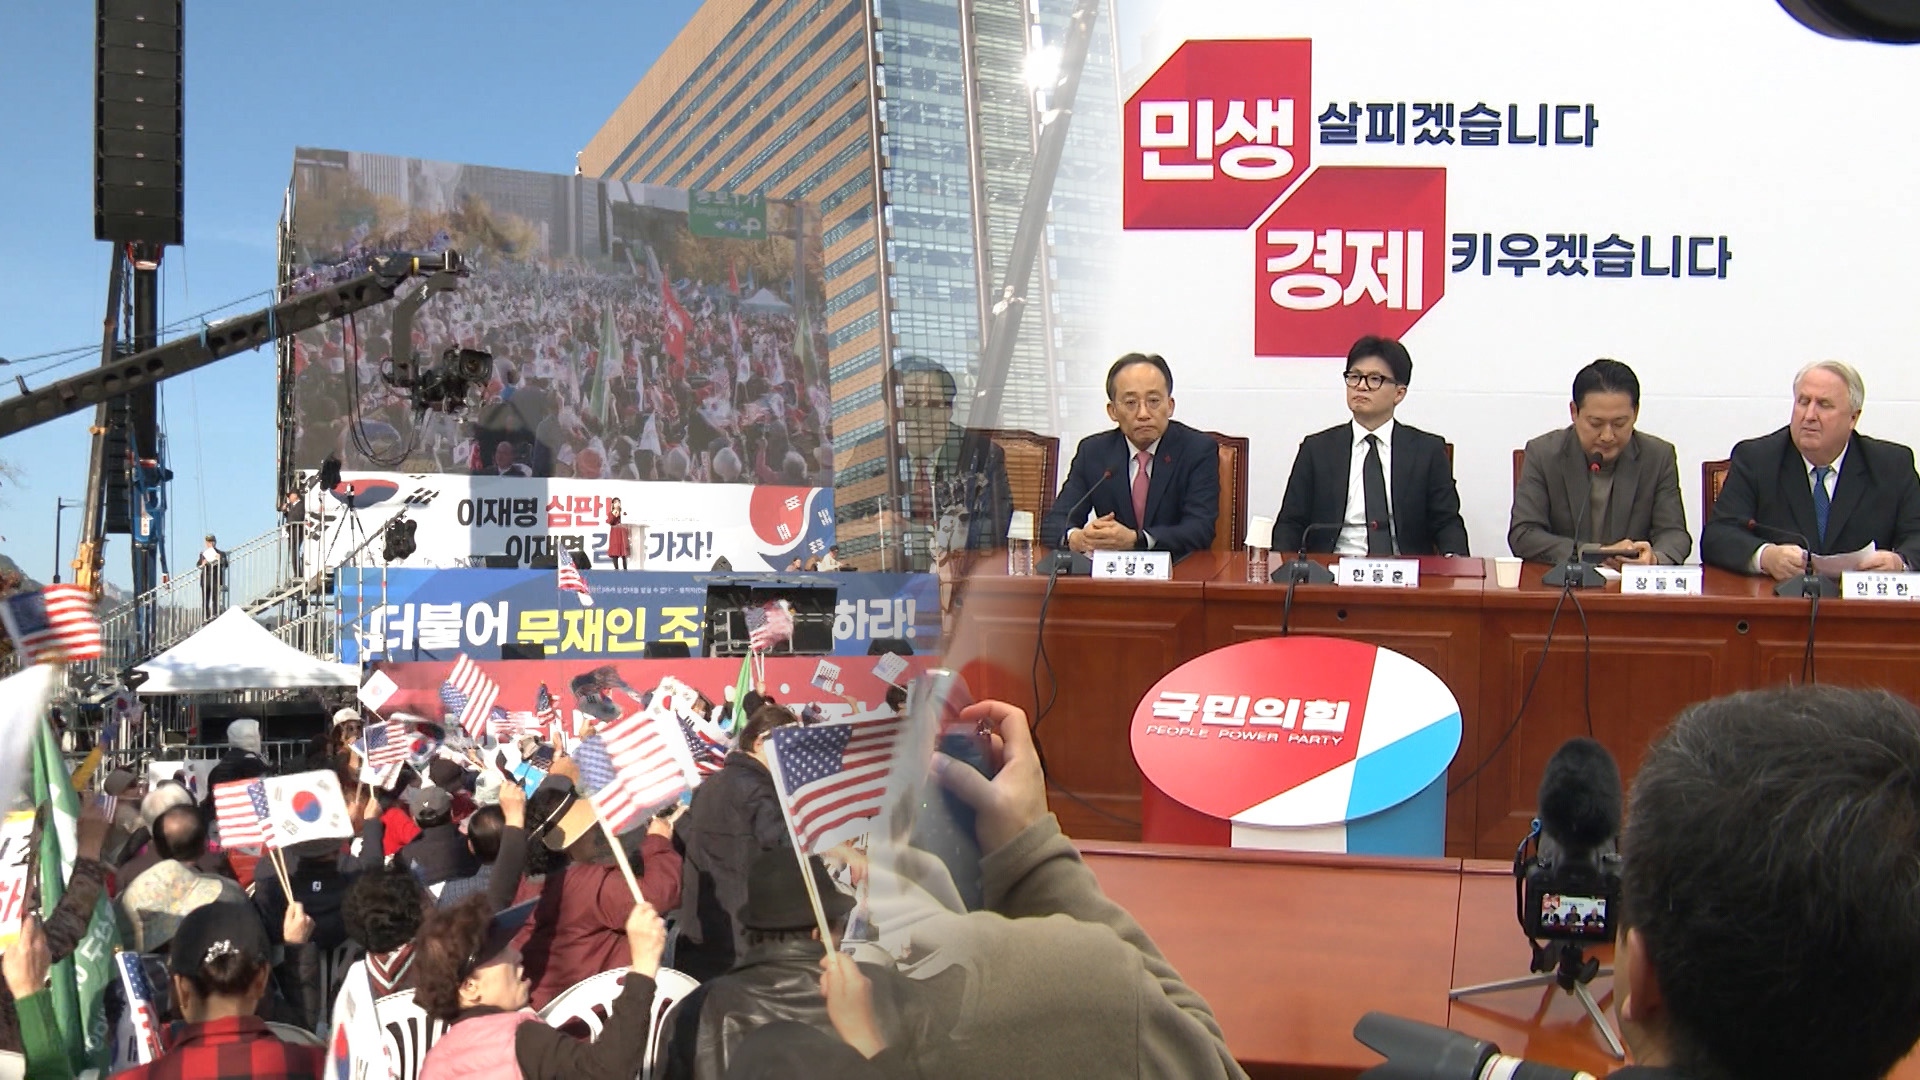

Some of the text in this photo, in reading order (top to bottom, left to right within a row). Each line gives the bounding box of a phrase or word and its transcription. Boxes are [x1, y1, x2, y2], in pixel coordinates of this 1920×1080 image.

[1140, 98, 1600, 181] 민생 살피겠습니다
[1266, 229, 1733, 312] 경제 키우겠습니다
[457, 496, 539, 528] 이재명
[648, 530, 713, 562] 가자!
[370, 600, 509, 651] 더불어
[516, 606, 647, 655] 문재인
[1152, 690, 1351, 734] 국민의힘
[1145, 724, 1343, 747] PEOPLE POWER PARTY
